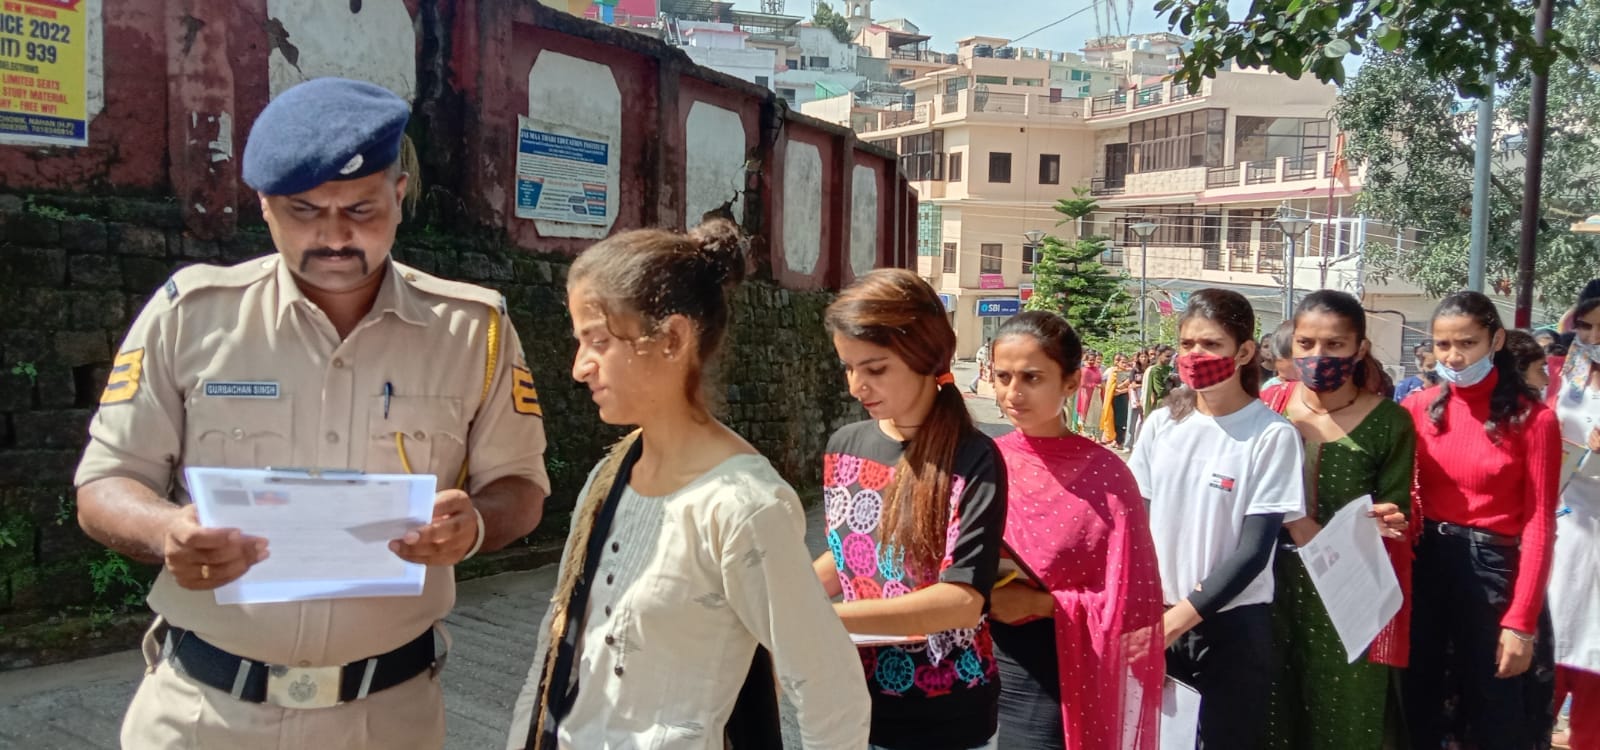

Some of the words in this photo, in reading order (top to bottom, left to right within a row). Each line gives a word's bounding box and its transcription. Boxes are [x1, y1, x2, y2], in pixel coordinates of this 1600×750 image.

[29, 19, 70, 44] 2022
[26, 42, 57, 64] 939
[2, 74, 34, 87] LIMITED
[37, 79, 60, 91] SEATS
[3, 87, 27, 99] STUDY
[29, 91, 68, 105] MATERIAL
[20, 101, 39, 112] FREE
[988, 304, 1000, 312] SBI
[252, 385, 276, 395] SINGH
